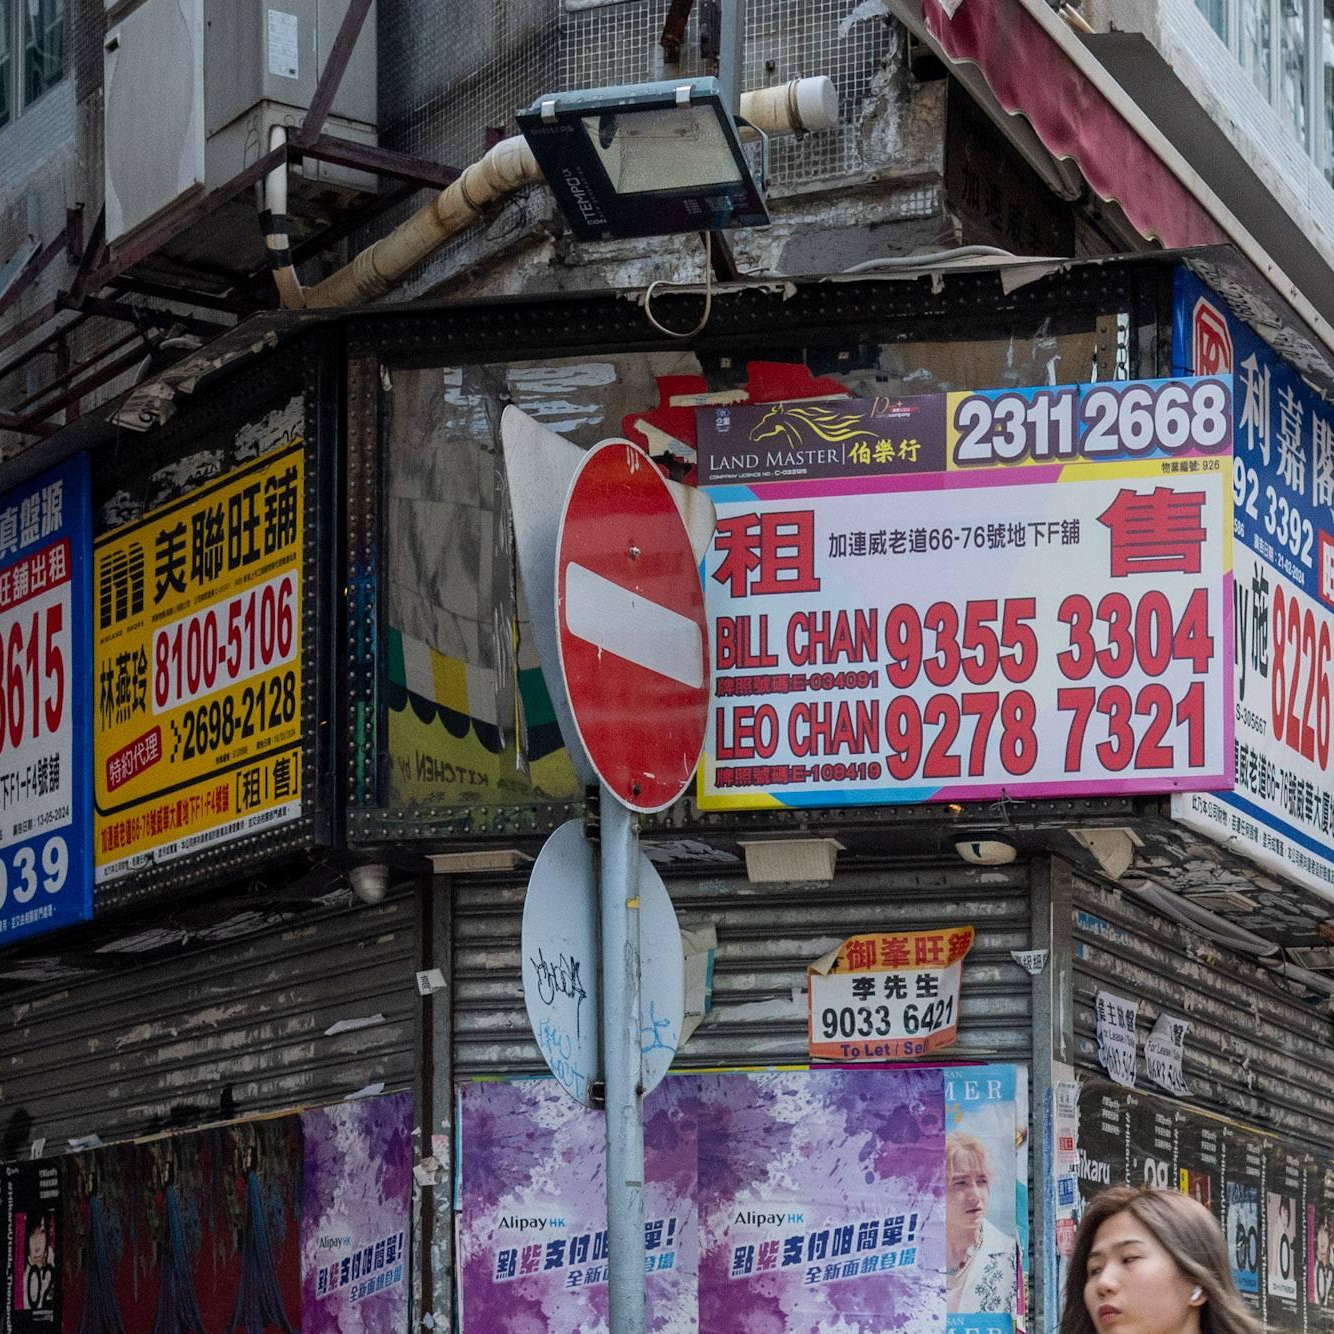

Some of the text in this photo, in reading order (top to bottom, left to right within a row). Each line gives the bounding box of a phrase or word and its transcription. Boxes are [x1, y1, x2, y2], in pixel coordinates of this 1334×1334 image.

[709, 438, 922, 471] LAND MASTER 伯樂行
[956, 384, 1228, 462] 2311 2668
[1202, 459, 1221, 472] 926
[153, 465, 299, 606] 美聯旺舖
[713, 509, 821, 599] 租
[828, 519, 1081, 560] 加連威老道66-76號地下F舖
[1097, 486, 1207, 578] 售
[1264, 485, 1314, 569] 3392
[99, 645, 148, 732] 林燕玲
[155, 576, 294, 708] 8100-5106
[716, 588, 1214, 689] BILL CHAN 9355 3304
[1271, 583, 1332, 772] 8226
[108, 731, 159, 788] 特約代理
[182, 670, 296, 762] 2698-2128
[716, 681, 1206, 781] LEO CHAN 9278 7321
[821, 995, 954, 1039] 9033 6421
[851, 973, 941, 1001] 李先生
[840, 1043, 860, 1058] To
[864, 1041, 891, 1057] Let
[803, 1246, 917, 1285] 全新面貌登場
